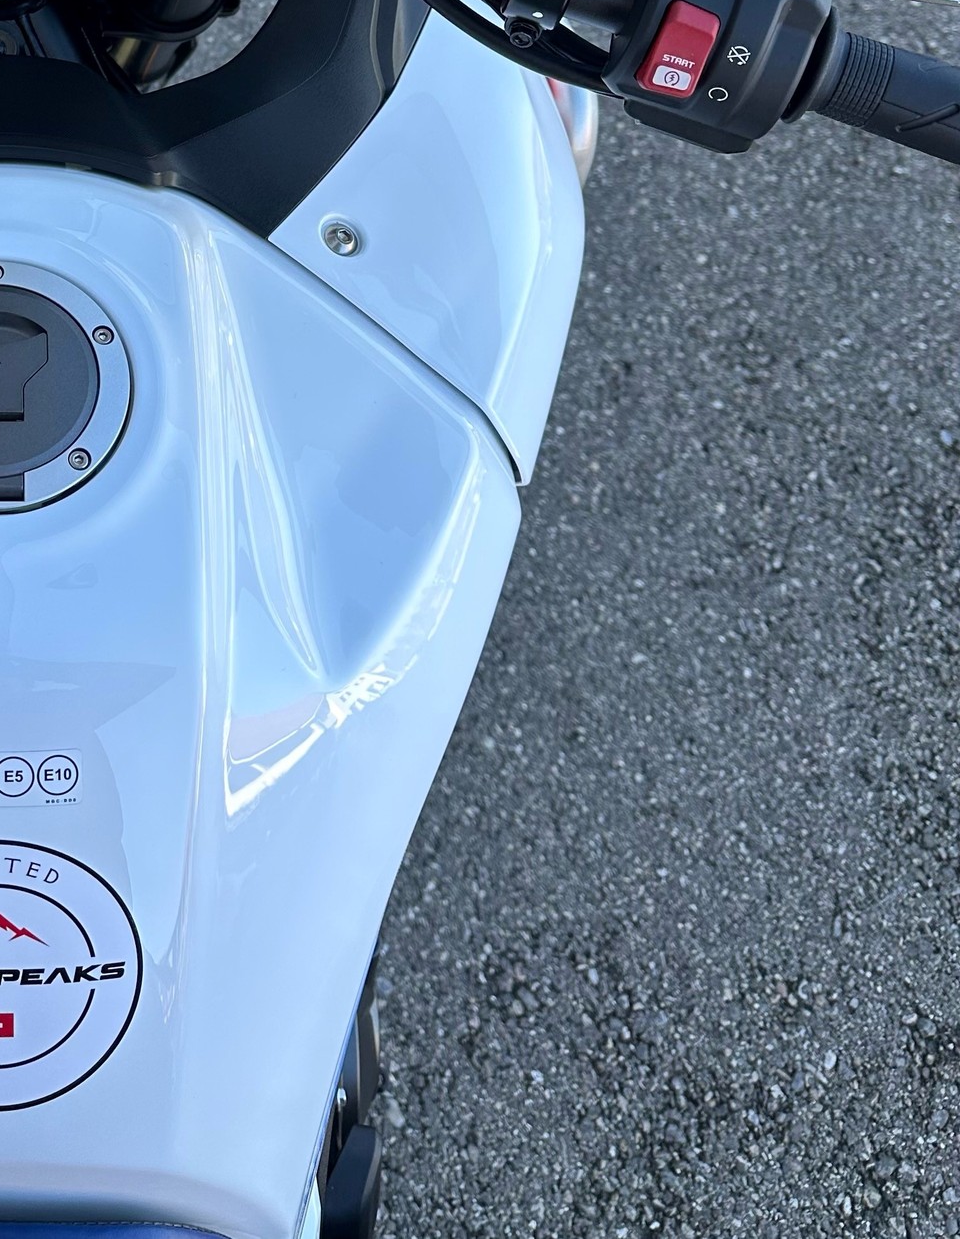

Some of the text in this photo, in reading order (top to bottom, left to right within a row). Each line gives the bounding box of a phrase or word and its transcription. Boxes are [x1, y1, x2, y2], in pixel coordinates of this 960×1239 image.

[662, 53, 696, 69] START
[4, 768, 72, 783] E5 E10
